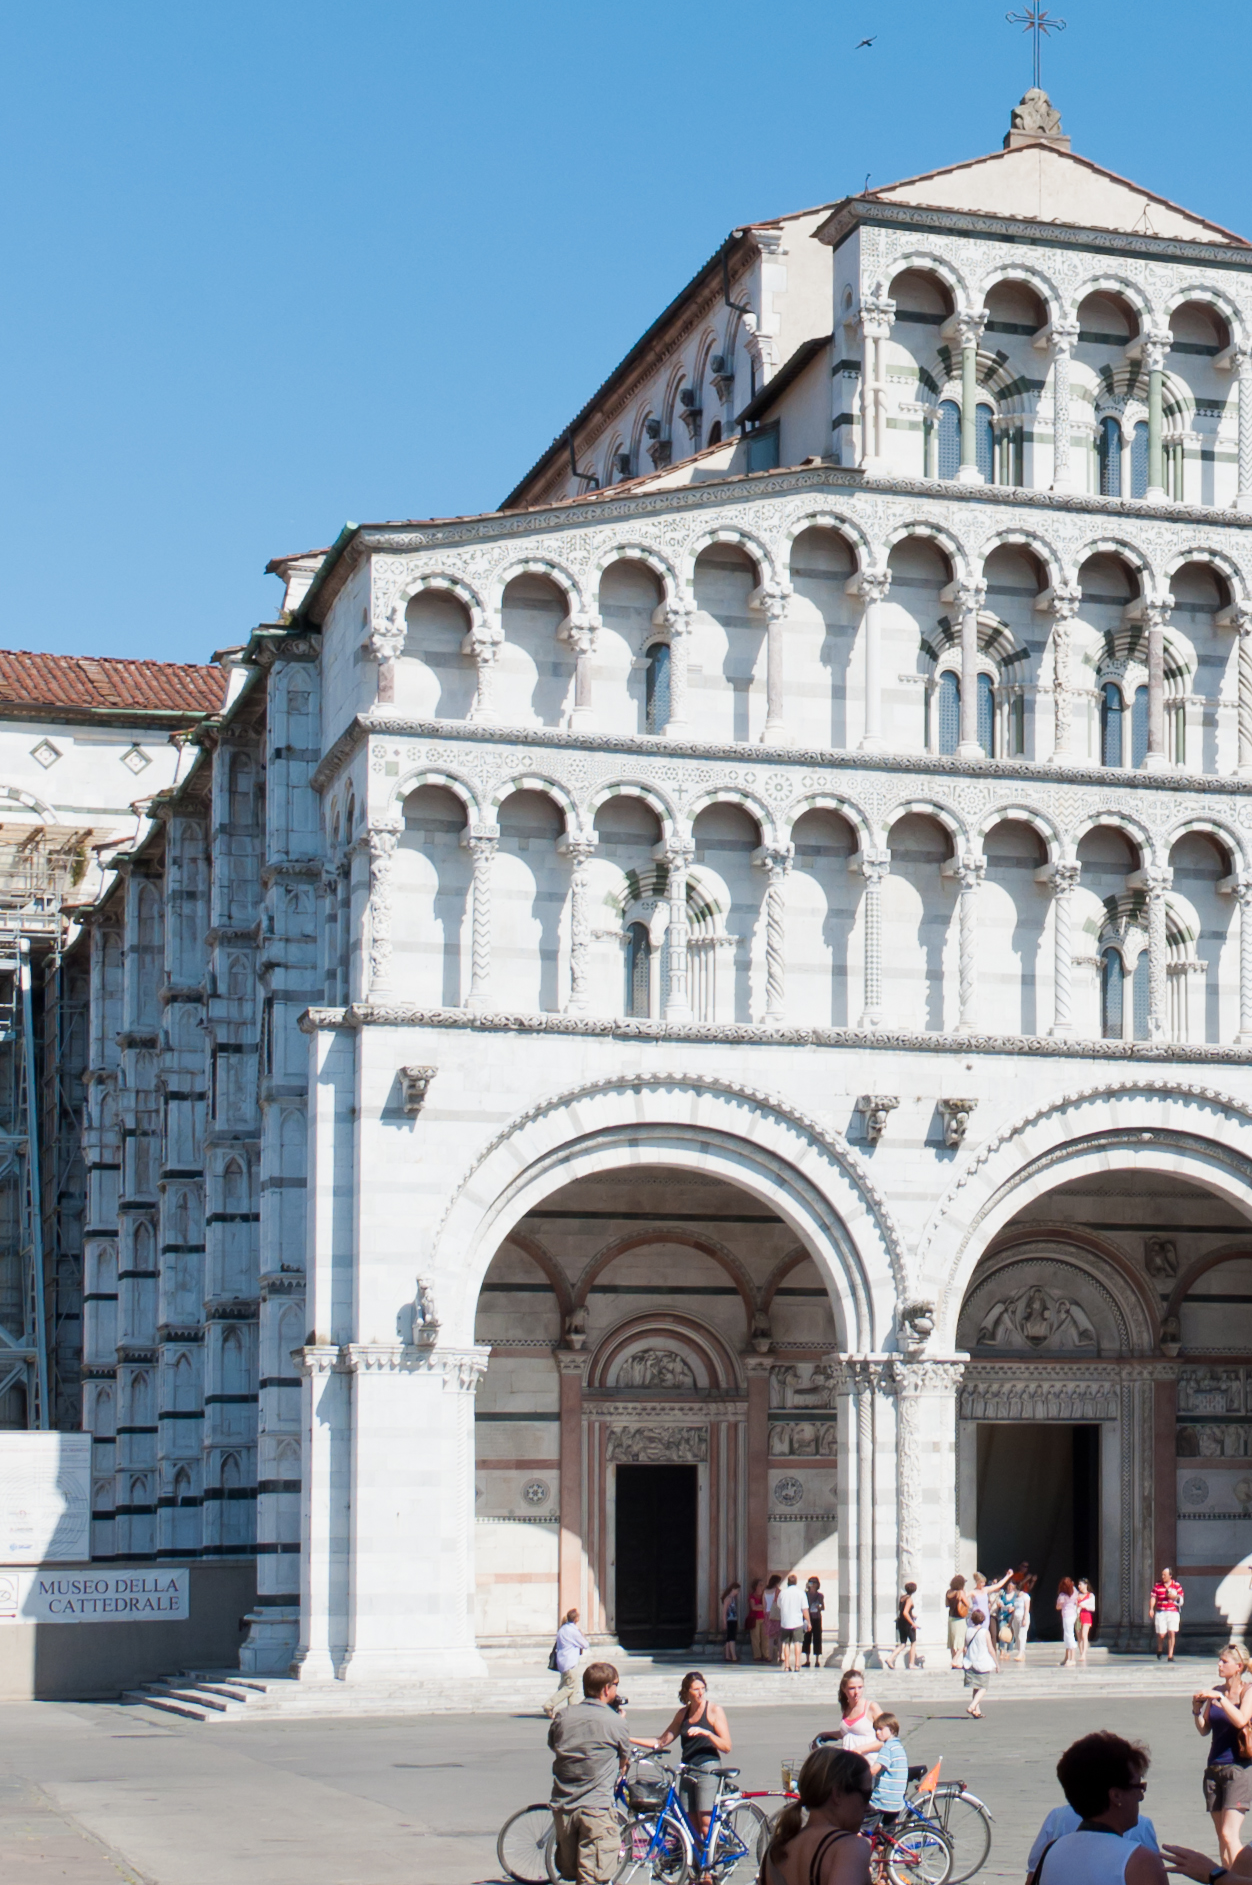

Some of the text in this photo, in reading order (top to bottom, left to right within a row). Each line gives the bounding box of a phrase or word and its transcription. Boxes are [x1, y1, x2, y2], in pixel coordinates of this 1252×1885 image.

[39, 1577, 179, 1595] MUSEO DELLA
[49, 1596, 180, 1613] CATTEDRALE
